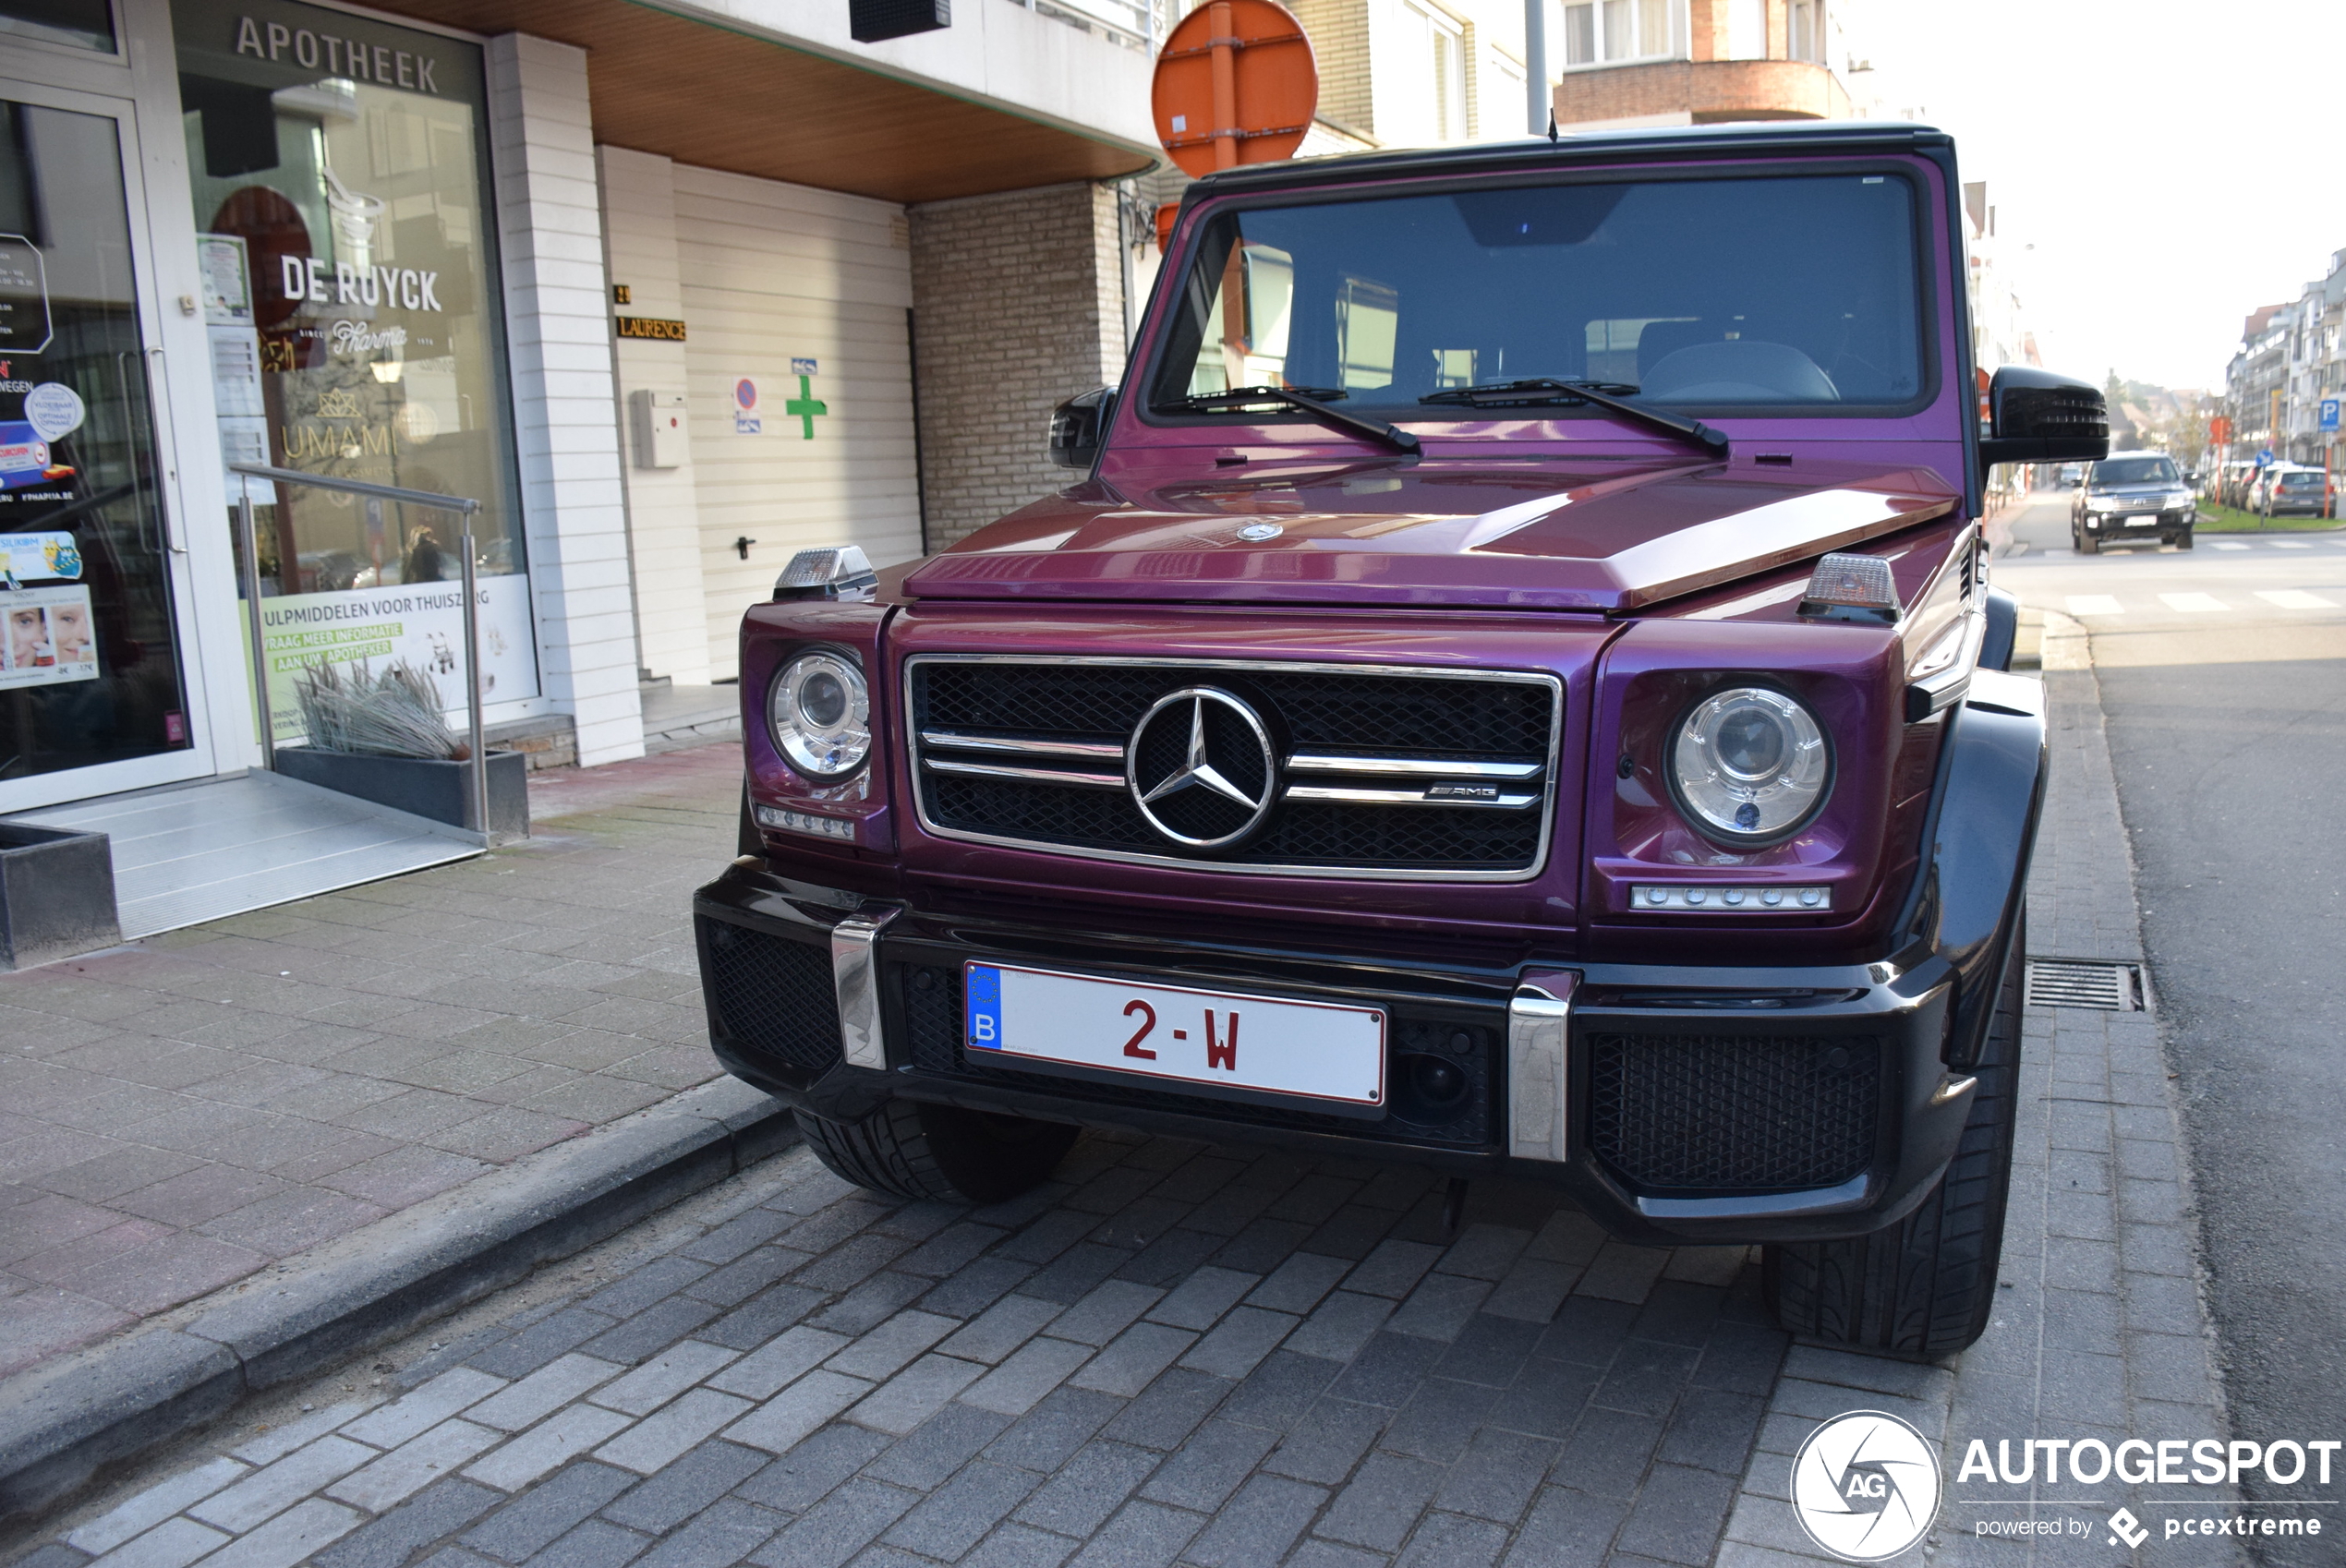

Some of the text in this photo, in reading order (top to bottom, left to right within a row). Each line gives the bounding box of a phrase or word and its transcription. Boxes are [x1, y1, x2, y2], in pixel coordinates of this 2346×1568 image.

[236, 16, 439, 93] APOTHEEK
[281, 255, 442, 312] DE RUYCK
[333, 320, 407, 355] Pharma
[620, 317, 686, 341] LAURENCE
[2323, 403, 2337, 421] P
[282, 425, 398, 459] UMAMI
[264, 589, 490, 626] ULPMIDDELEN VOOR THUISZRG
[302, 631, 334, 646] MEER
[335, 622, 401, 643] INFORMATIE
[278, 657, 302, 670] AAN
[327, 641, 391, 663] APOTHEKER
[1453, 787, 1496, 796] AMG
[975, 1014, 996, 1042] B
[1122, 999, 1240, 1071] 2-W
